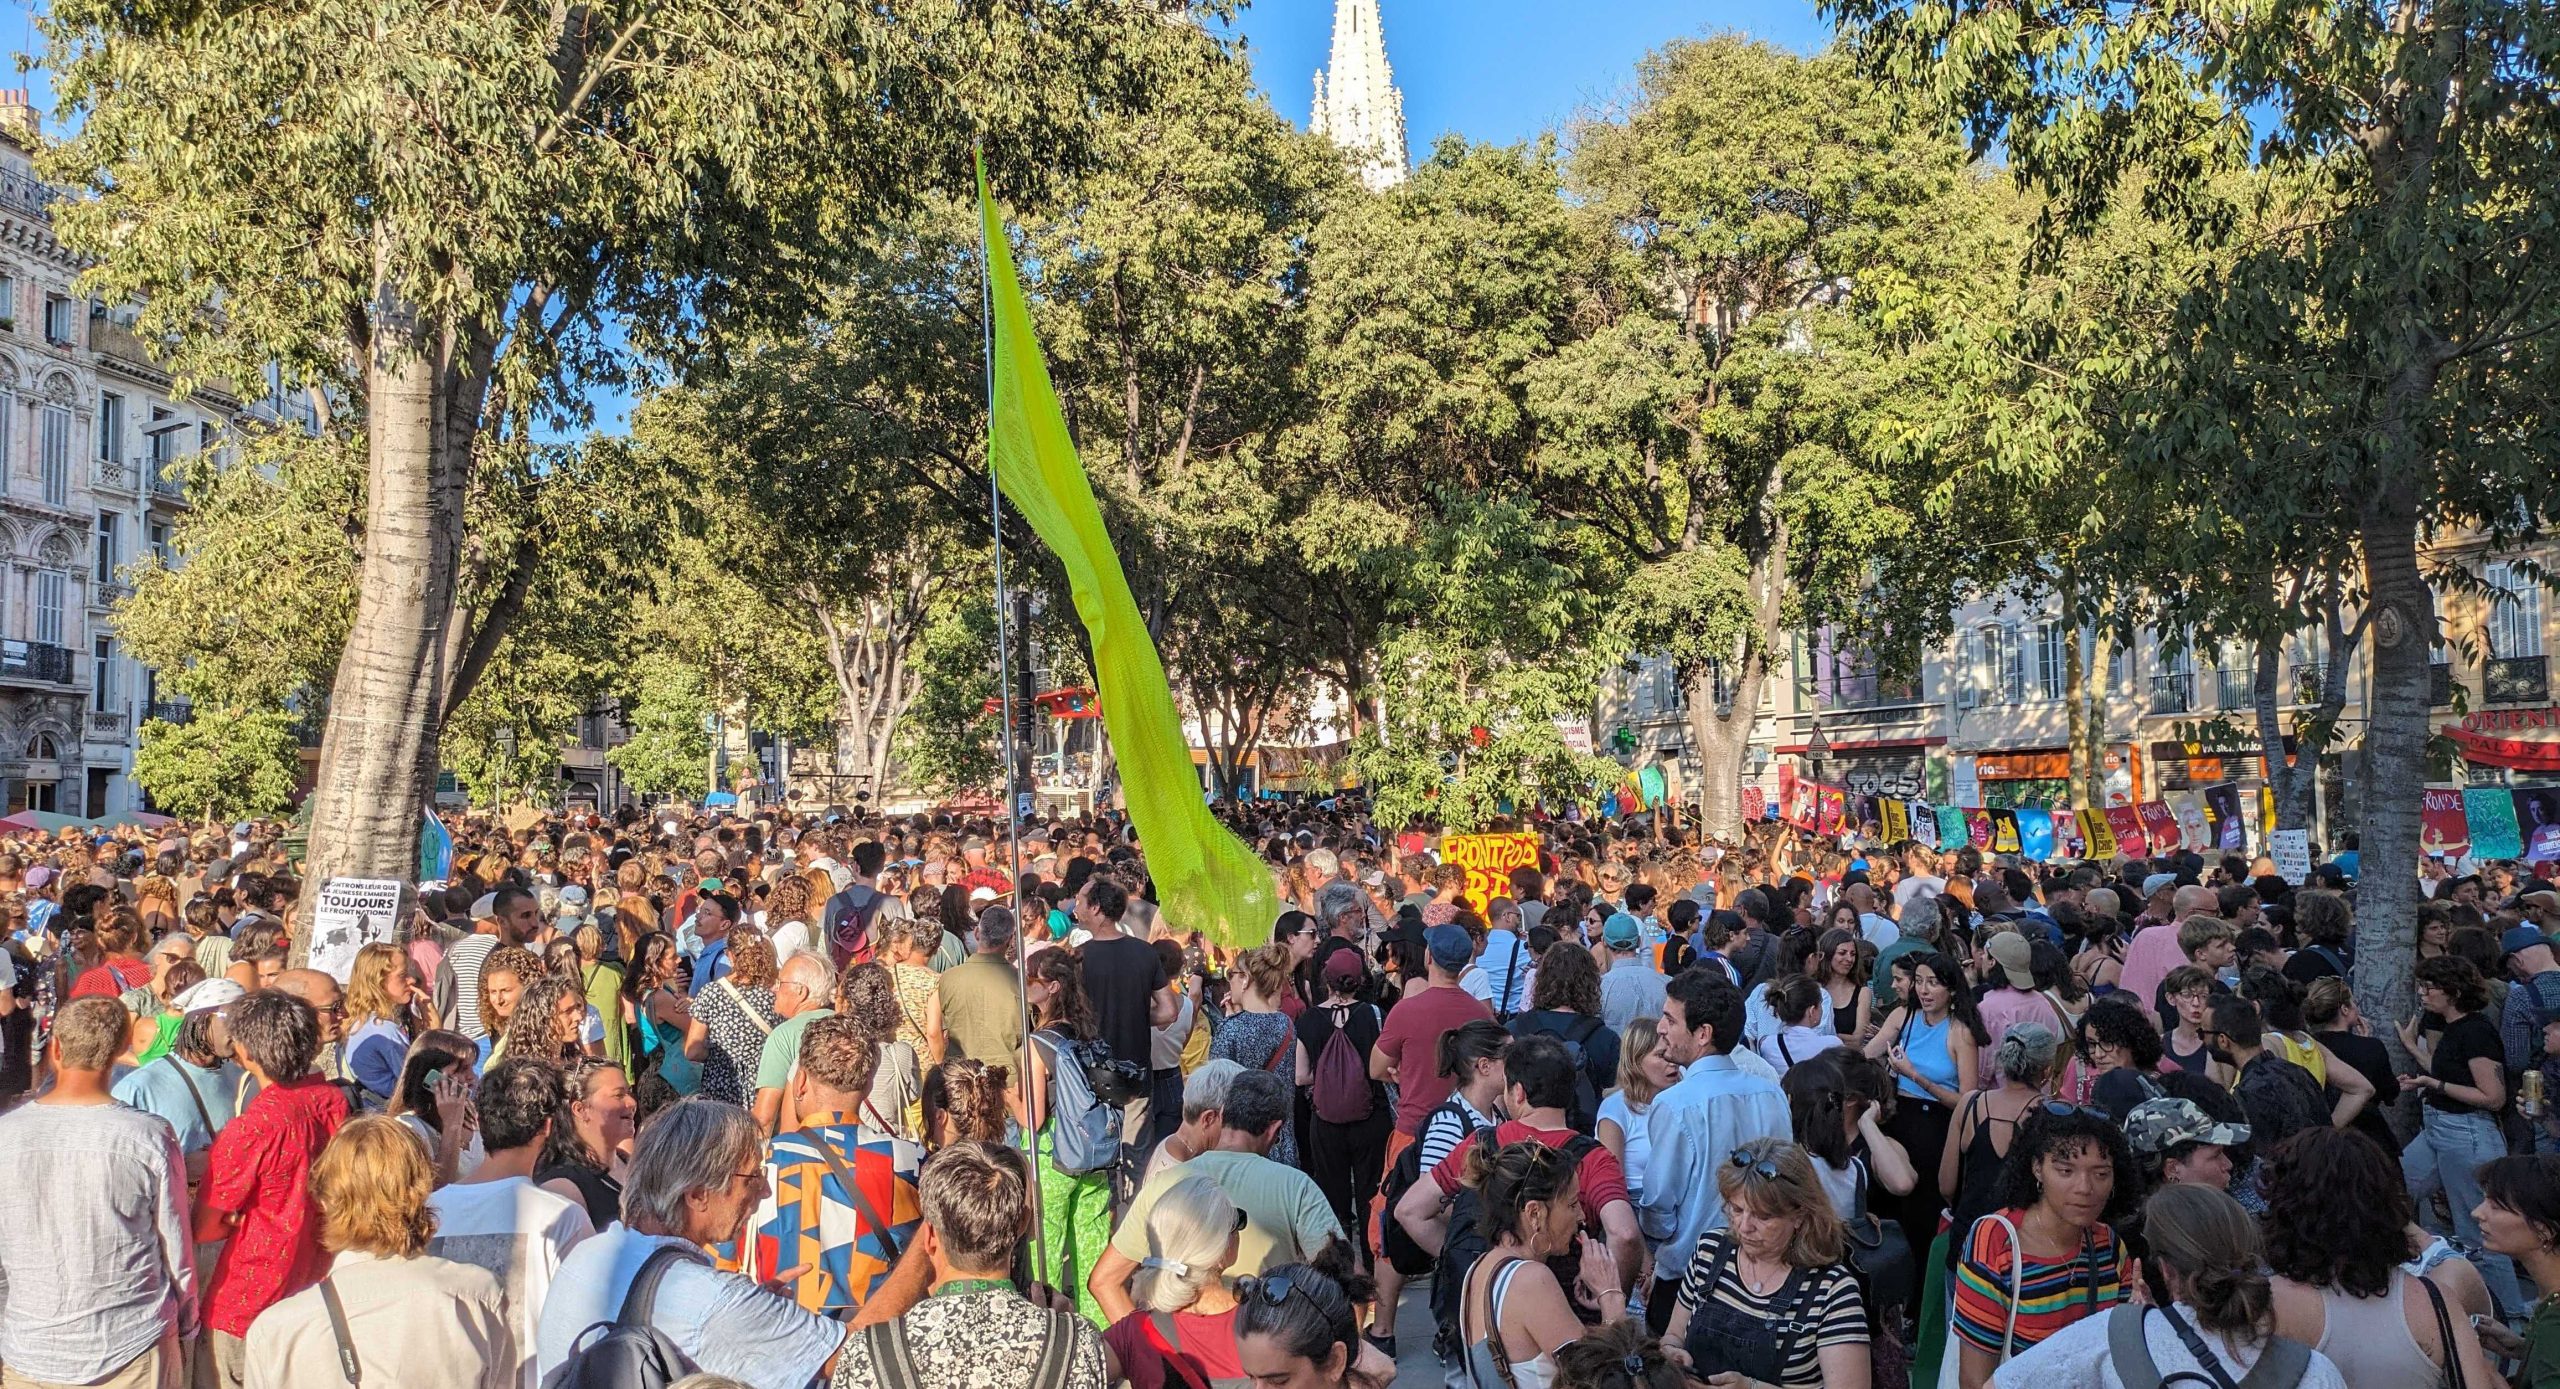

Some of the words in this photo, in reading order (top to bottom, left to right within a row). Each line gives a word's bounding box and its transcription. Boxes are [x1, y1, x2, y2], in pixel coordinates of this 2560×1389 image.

[2469, 737, 2538, 755] PALAIS
[2104, 753, 2120, 764] ria
[1979, 762, 1995, 775] ria
[322, 895, 395, 909] TOUJOURS
[329, 907, 355, 915] FRONT
[355, 909, 392, 917] NATIONAL
